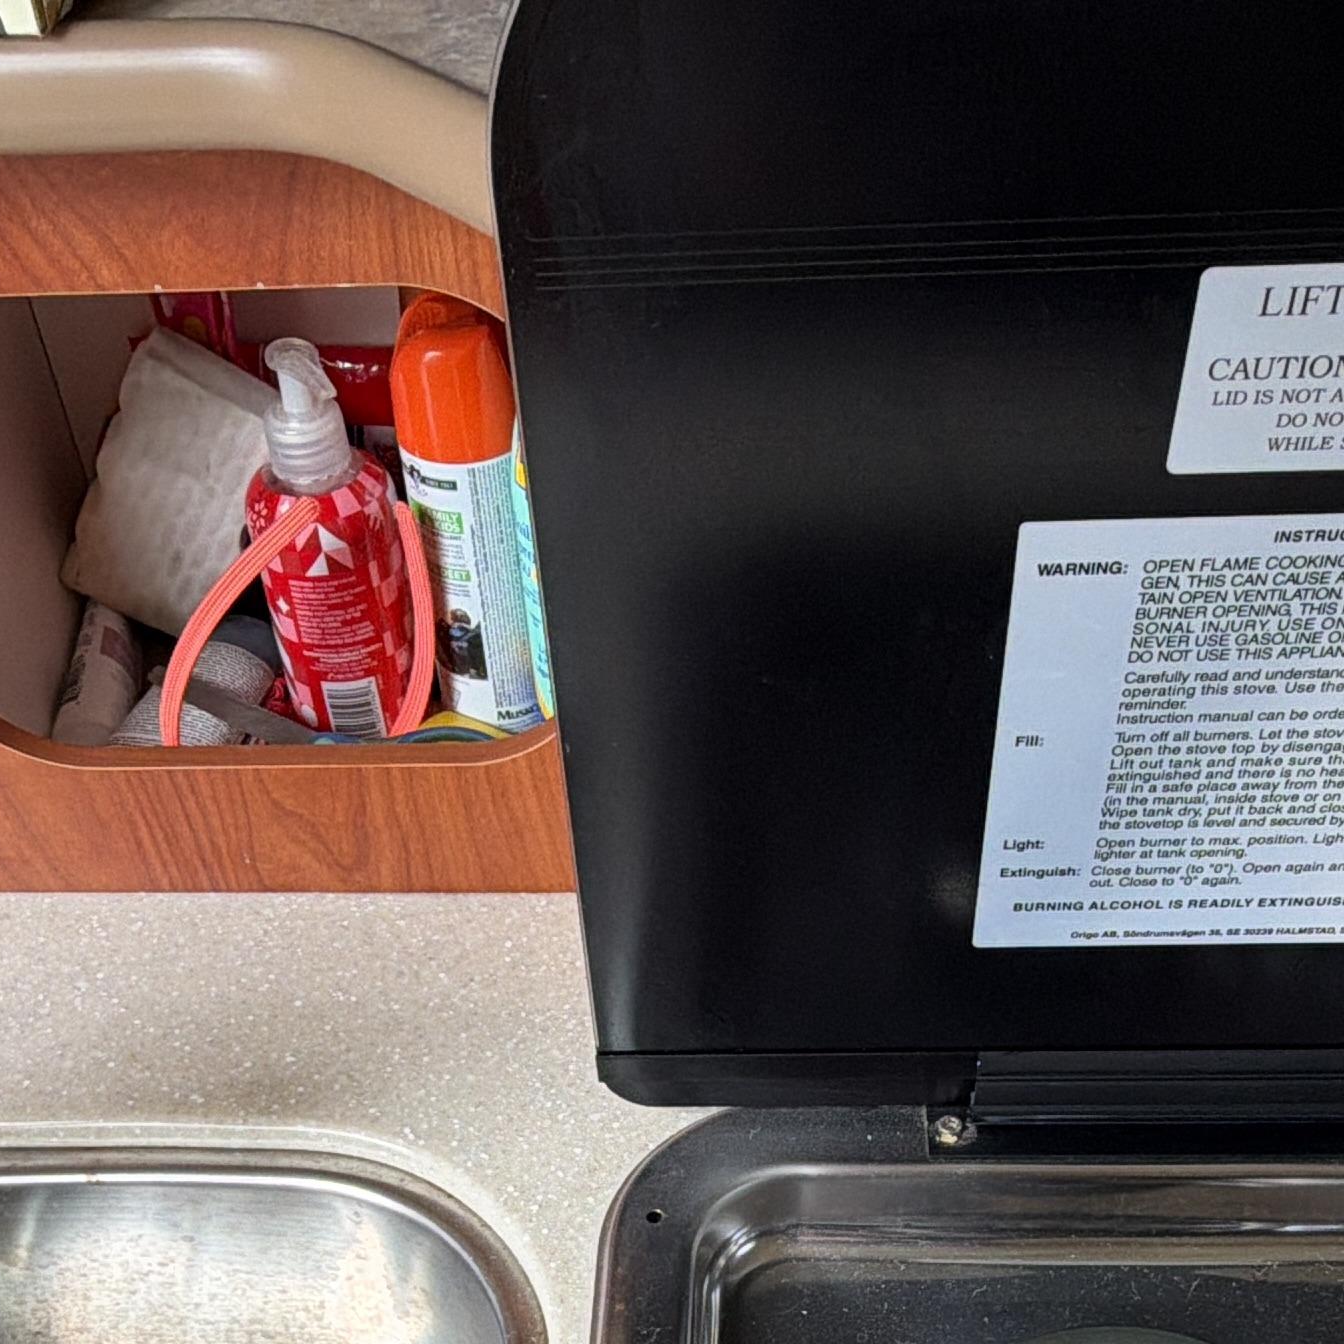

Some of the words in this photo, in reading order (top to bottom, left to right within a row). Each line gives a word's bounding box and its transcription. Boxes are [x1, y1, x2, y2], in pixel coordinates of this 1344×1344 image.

[1212, 390, 1248, 406] LID
[1253, 389, 1274, 405] IS
[1279, 387, 1327, 404] NOT
[1328, 387, 1344, 403] A
[1275, 412, 1308, 428] DO
[1268, 435, 1334, 451] WHILE
[1037, 561, 1127, 576] WARNING:
[1143, 558, 1195, 574] OPEN
[1199, 556, 1260, 572] FLAME
[1187, 573, 1226, 588] THIS
[1230, 572, 1269, 587] CAN
[1272, 570, 1331, 586] CAUSE
[1138, 591, 1175, 605] TAIN
[1178, 590, 1228, 604] OPEN
[1134, 605, 1208, 621] BURNER
[1299, 601, 1338, 616] THIS
[1132, 621, 1194, 636] SONAL
[1277, 616, 1316, 632] USE
[1130, 634, 1190, 649] NEVER
[1194, 633, 1231, 648] USE
[1234, 631, 1323, 646] GASOLINE
[1127, 649, 1154, 664] DO
[1156, 648, 1193, 663] NOT
[1195, 647, 1231, 662] USE
[1235, 646, 1273, 660] THIS
[1014, 734, 1043, 747] Fill:
[1002, 839, 1044, 852] Light:
[999, 866, 1080, 879] Extinguish:
[1012, 901, 1084, 912] BURNING
[1088, 899, 1163, 911] ALCOHOL
[1168, 898, 1183, 909] IS
[1187, 898, 1253, 909] READILY
